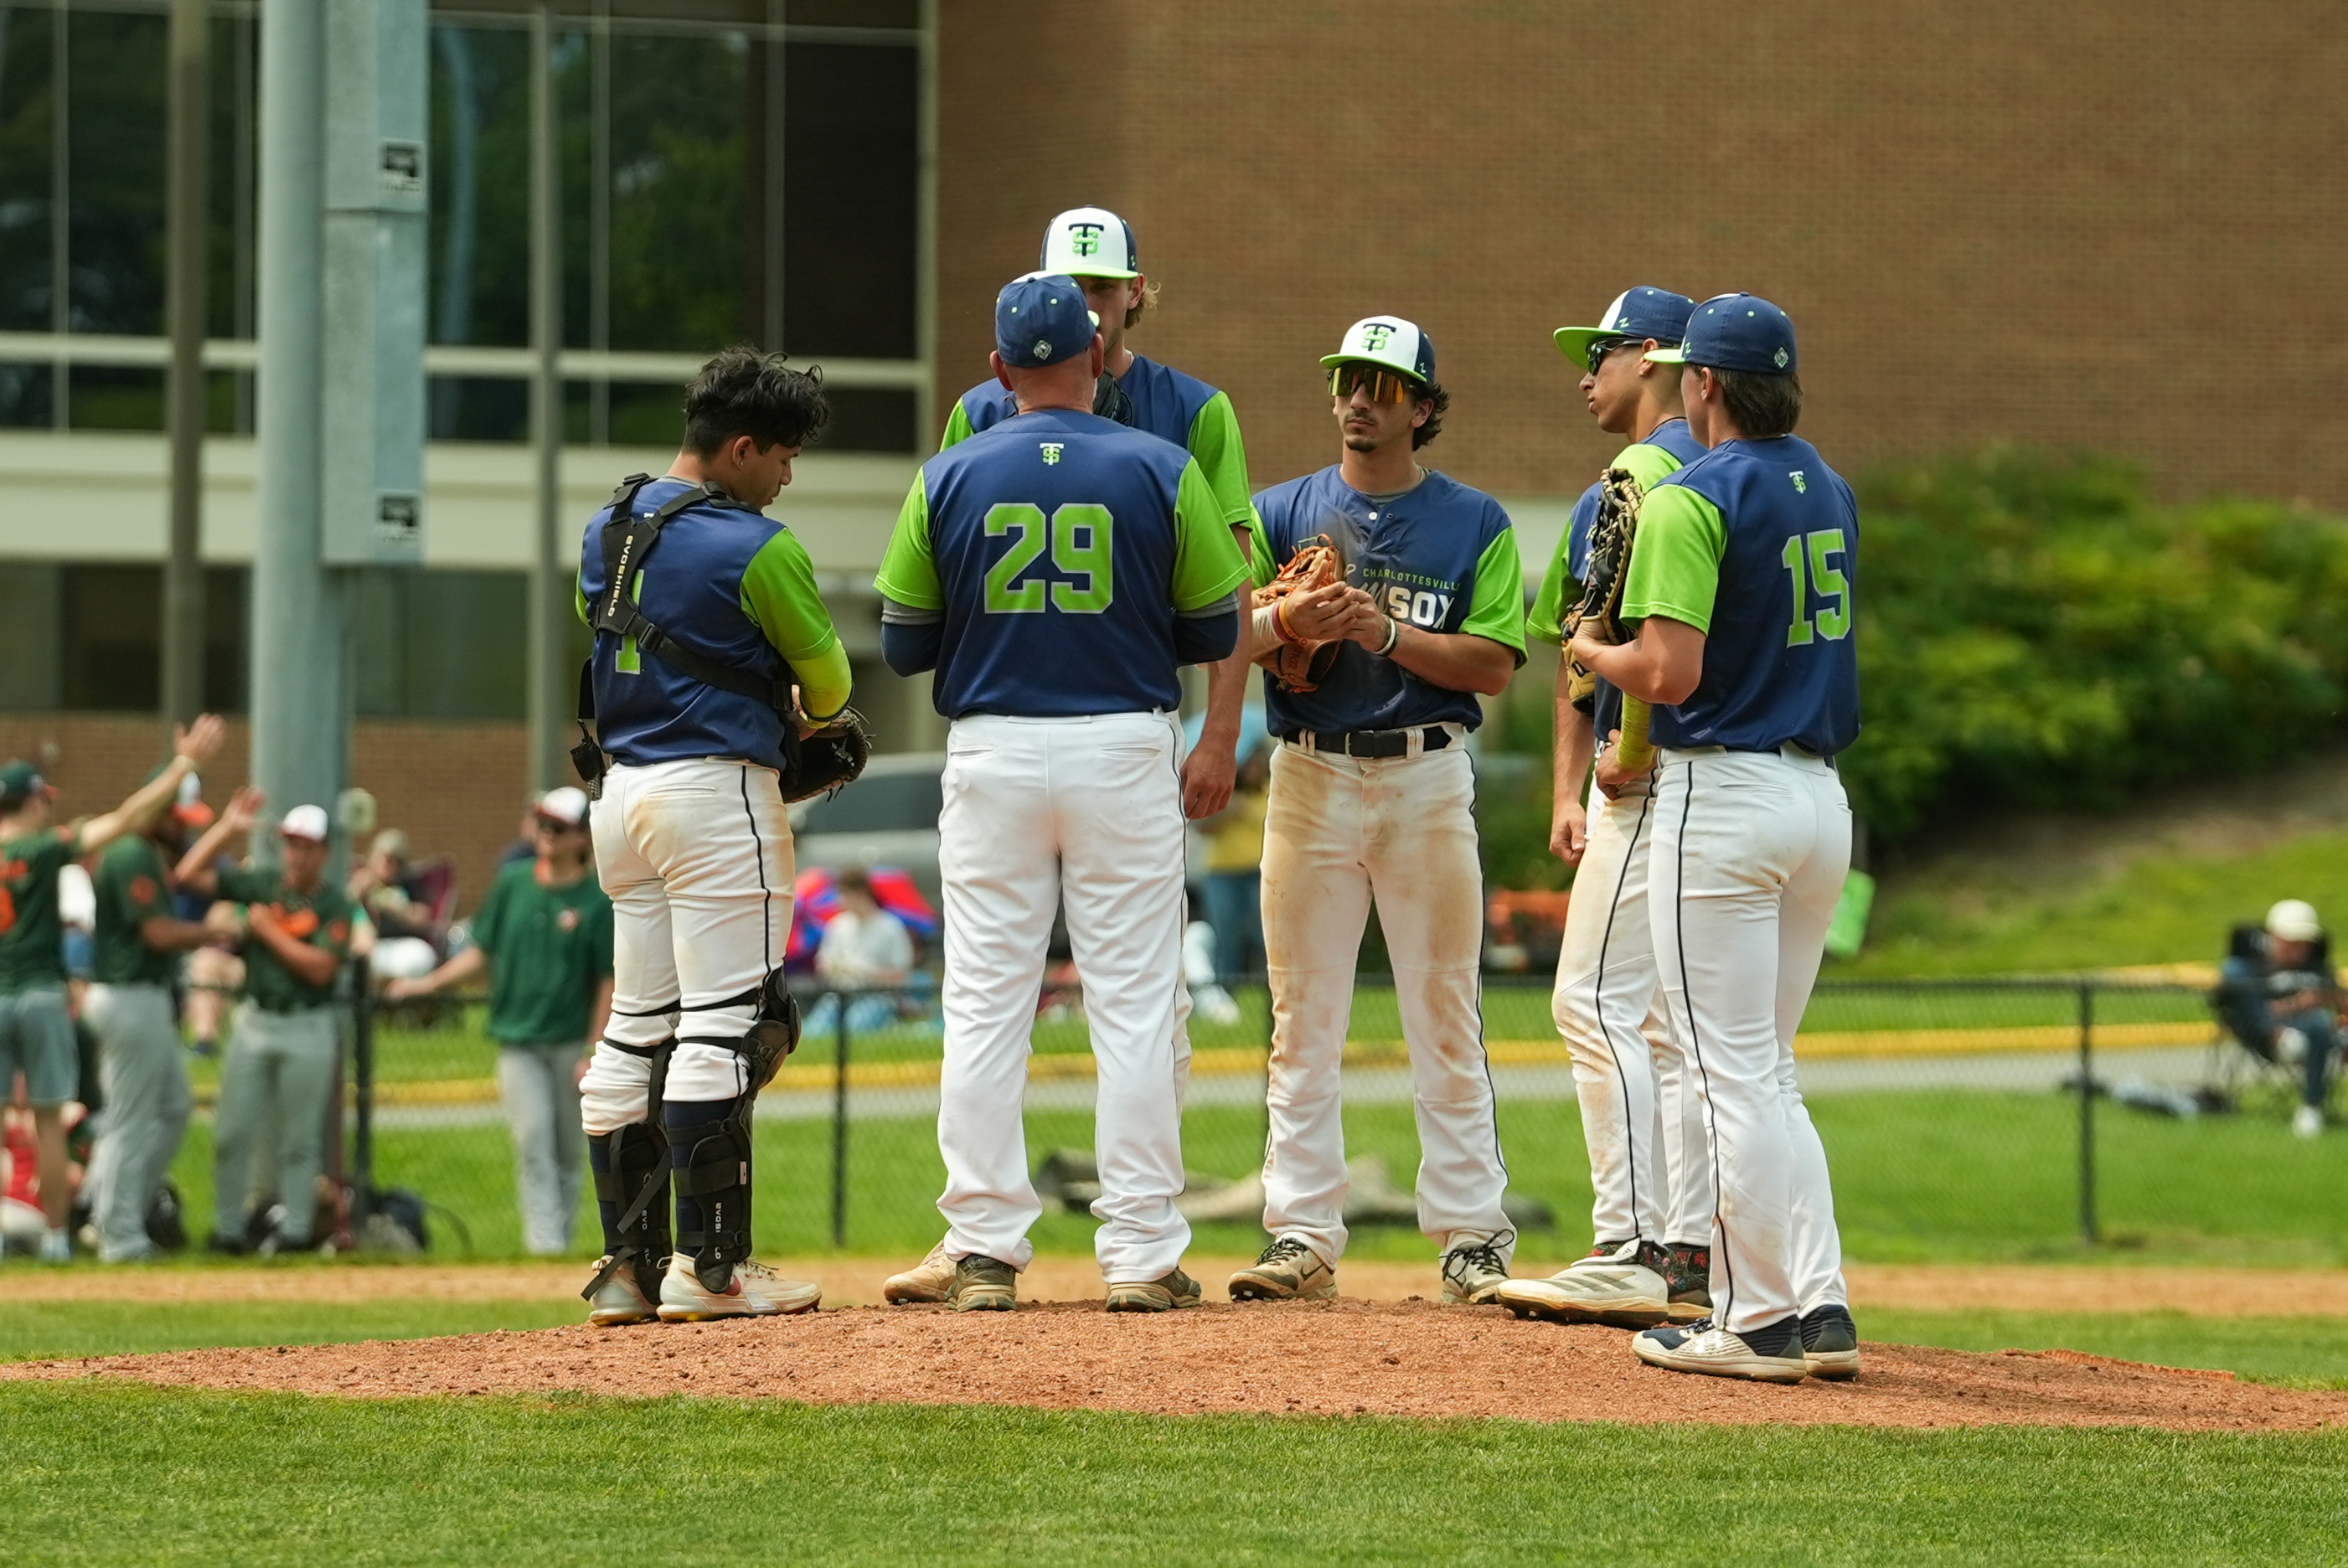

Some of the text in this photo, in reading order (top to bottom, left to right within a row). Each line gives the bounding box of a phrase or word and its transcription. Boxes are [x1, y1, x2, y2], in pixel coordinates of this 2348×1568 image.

[607, 535, 634, 617] EVOSHIELD
[983, 503, 1114, 614] 29
[1363, 568, 1460, 591] CHARLOTTESVILL
[1782, 529, 1851, 648] 15
[1388, 585, 1455, 630] SOX
